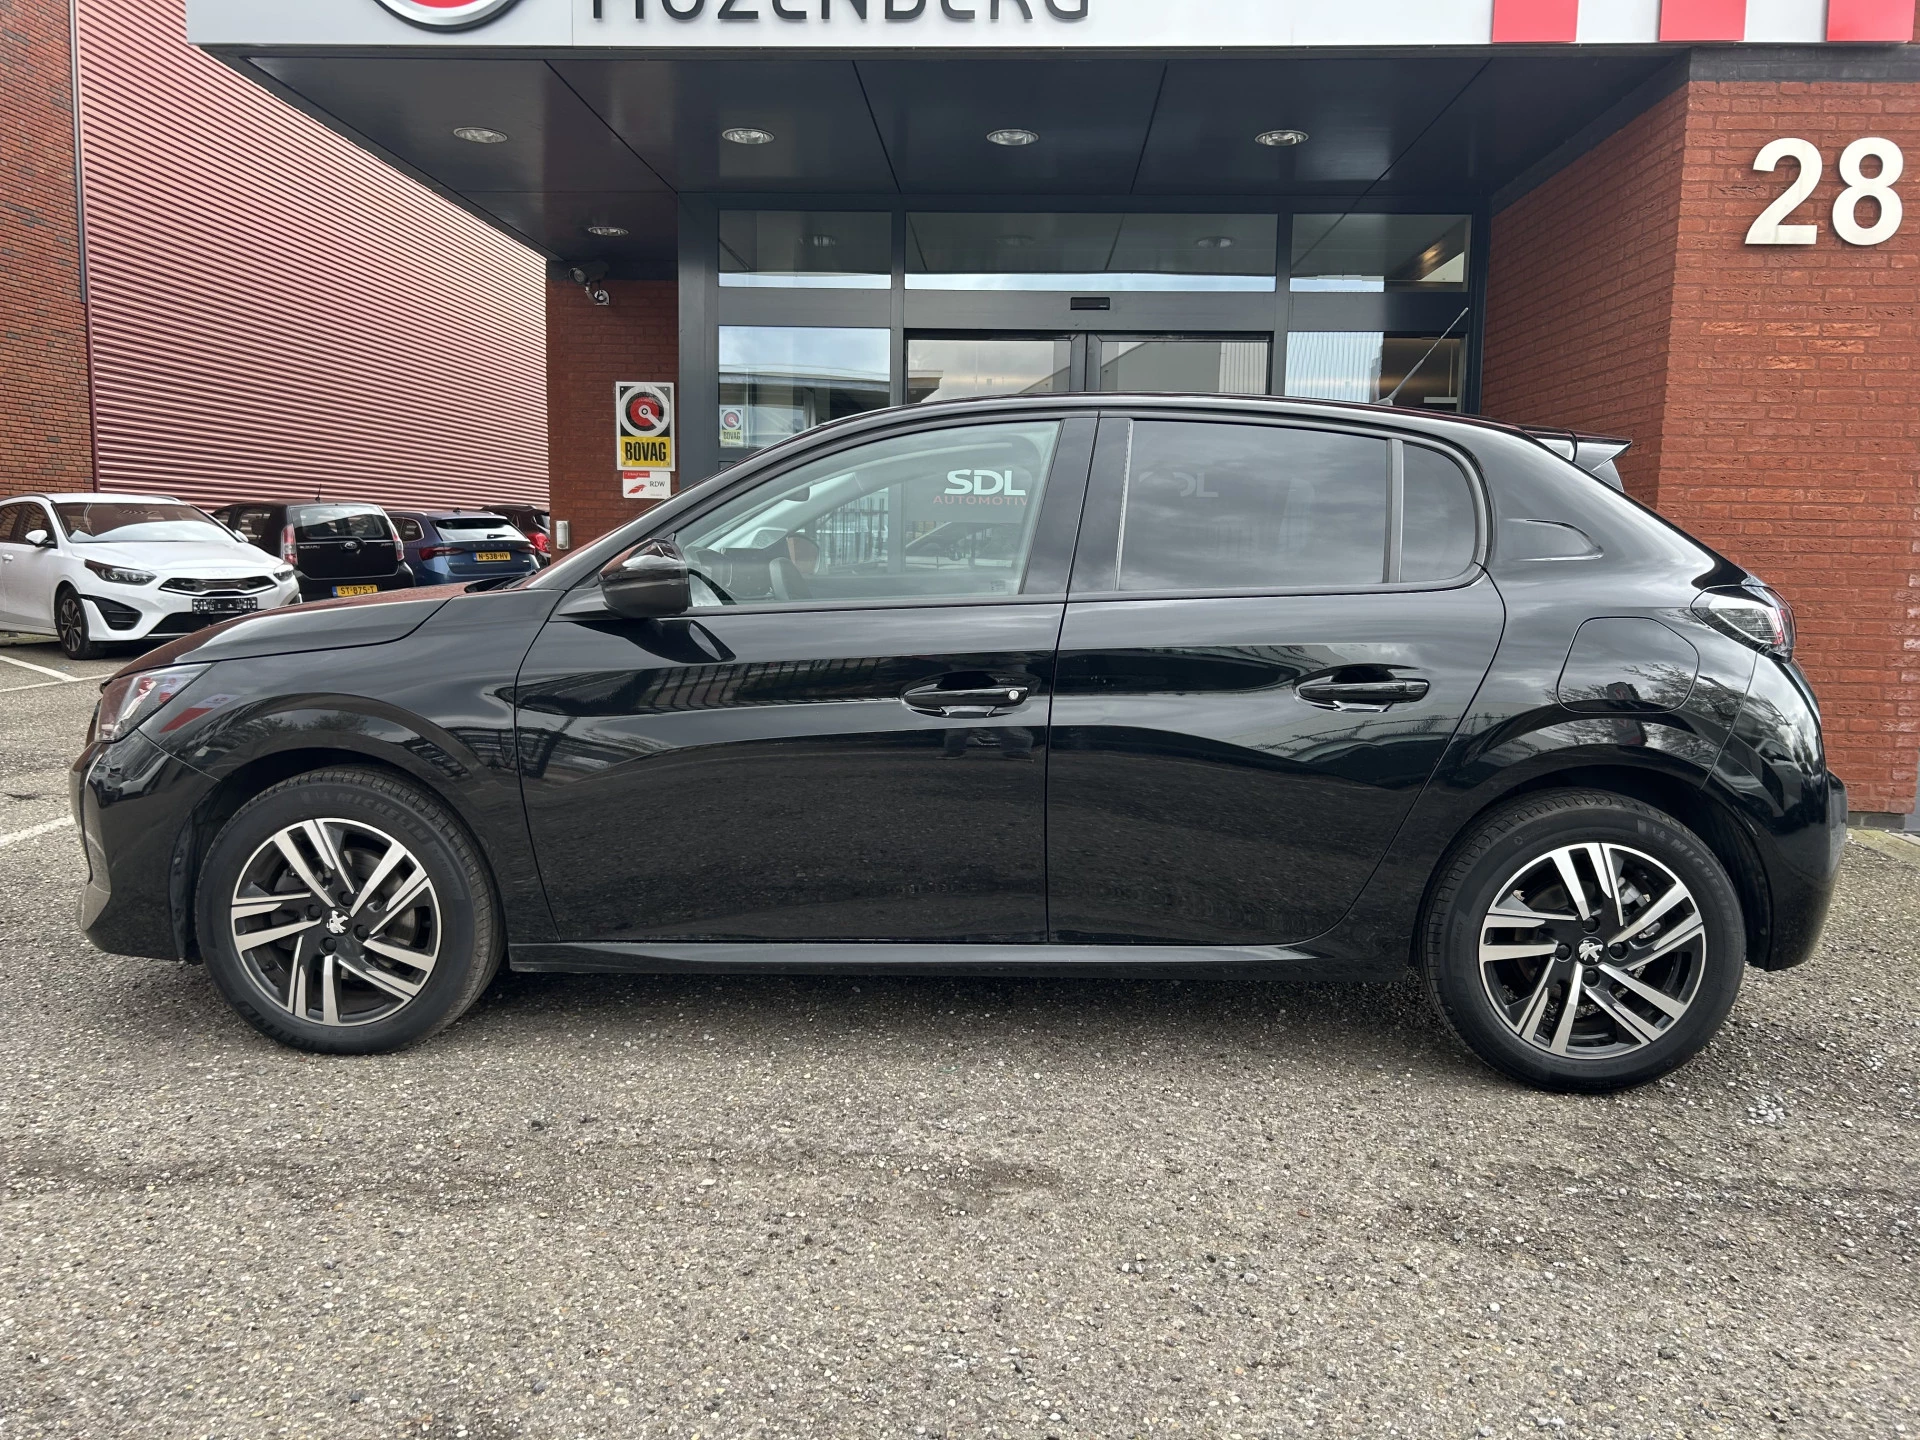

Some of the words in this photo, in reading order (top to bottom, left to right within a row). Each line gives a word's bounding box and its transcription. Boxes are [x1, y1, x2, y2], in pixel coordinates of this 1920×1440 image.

[1745, 137, 1903, 246] 28
[625, 441, 667, 461] BOVAG
[649, 480, 666, 488] RDW
[944, 469, 1026, 495] SDL
